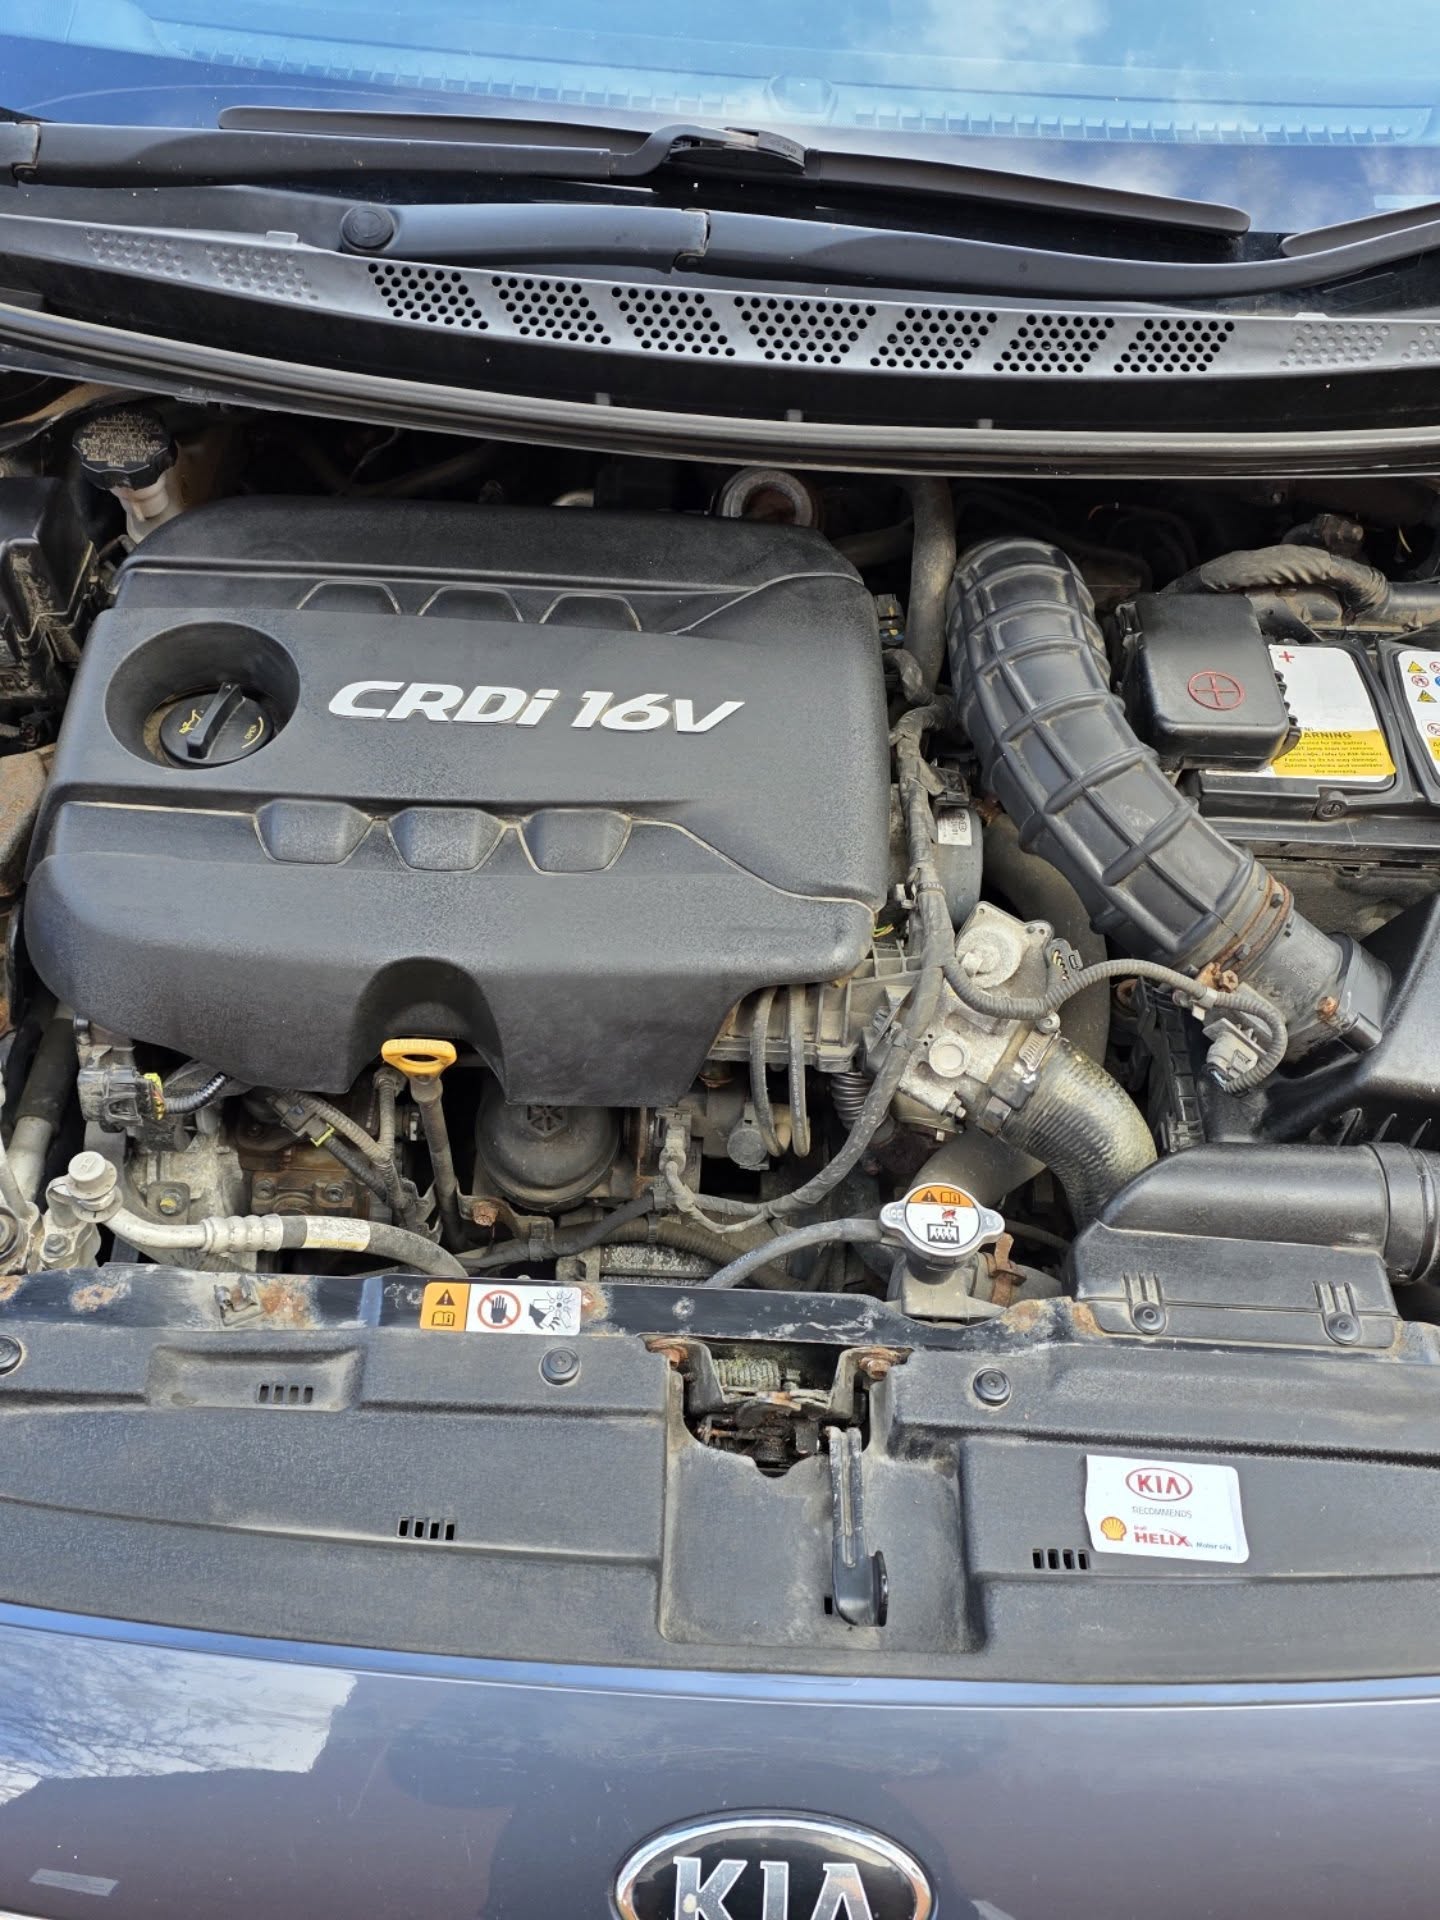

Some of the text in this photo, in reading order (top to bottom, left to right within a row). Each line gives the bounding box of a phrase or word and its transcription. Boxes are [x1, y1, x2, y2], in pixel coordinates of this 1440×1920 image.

[328, 681, 746, 733] CRDi 16V
[1303, 731, 1352, 739] ARNING
[1137, 1474, 1182, 1496] KIA
[1132, 1506, 1193, 1519] RECOMMENDS
[1134, 1531, 1192, 1548] HELIX
[673, 1856, 875, 1920] KIA
